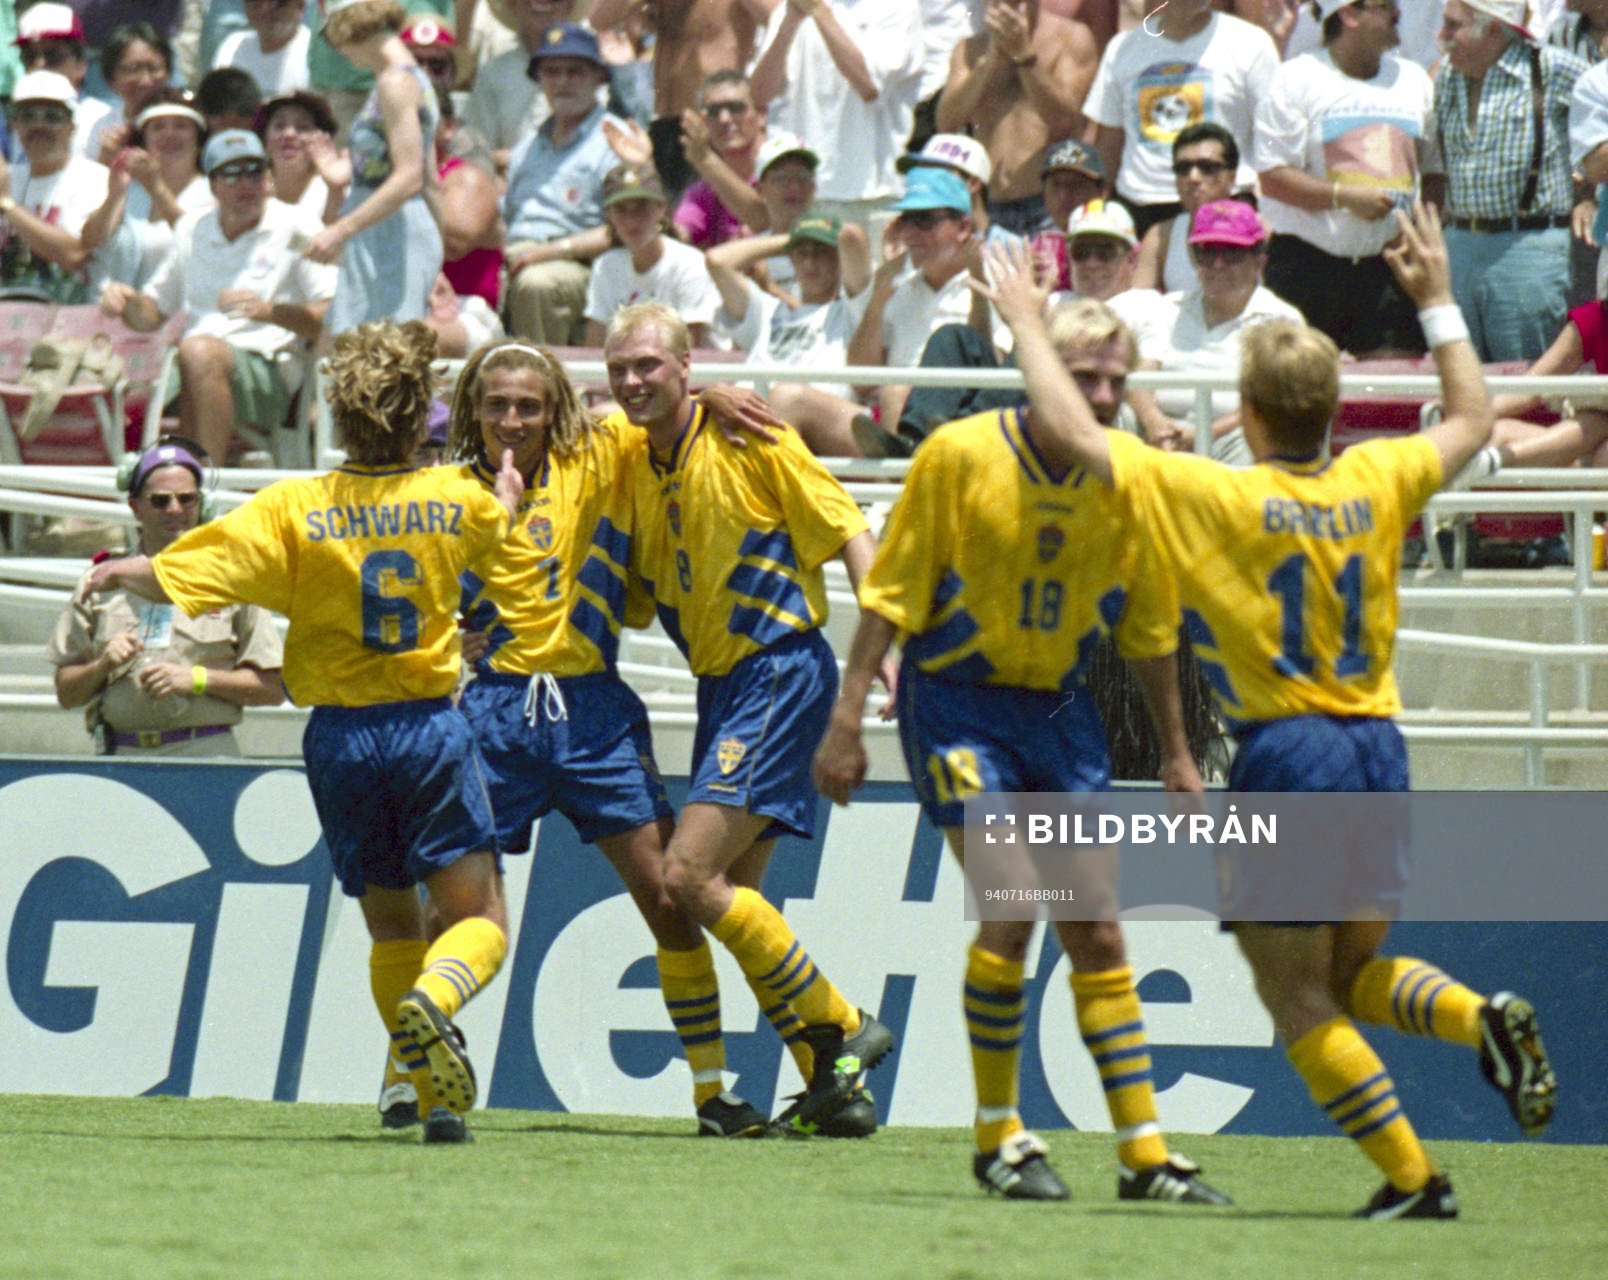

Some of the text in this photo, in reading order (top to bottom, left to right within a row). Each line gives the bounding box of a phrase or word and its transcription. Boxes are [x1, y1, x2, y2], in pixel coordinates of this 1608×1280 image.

[306, 500, 464, 541] SCHWARZ
[675, 548, 693, 593] 8
[360, 549, 425, 655] 6
[1018, 576, 1066, 632] 18
[1268, 552, 1370, 681] 11
